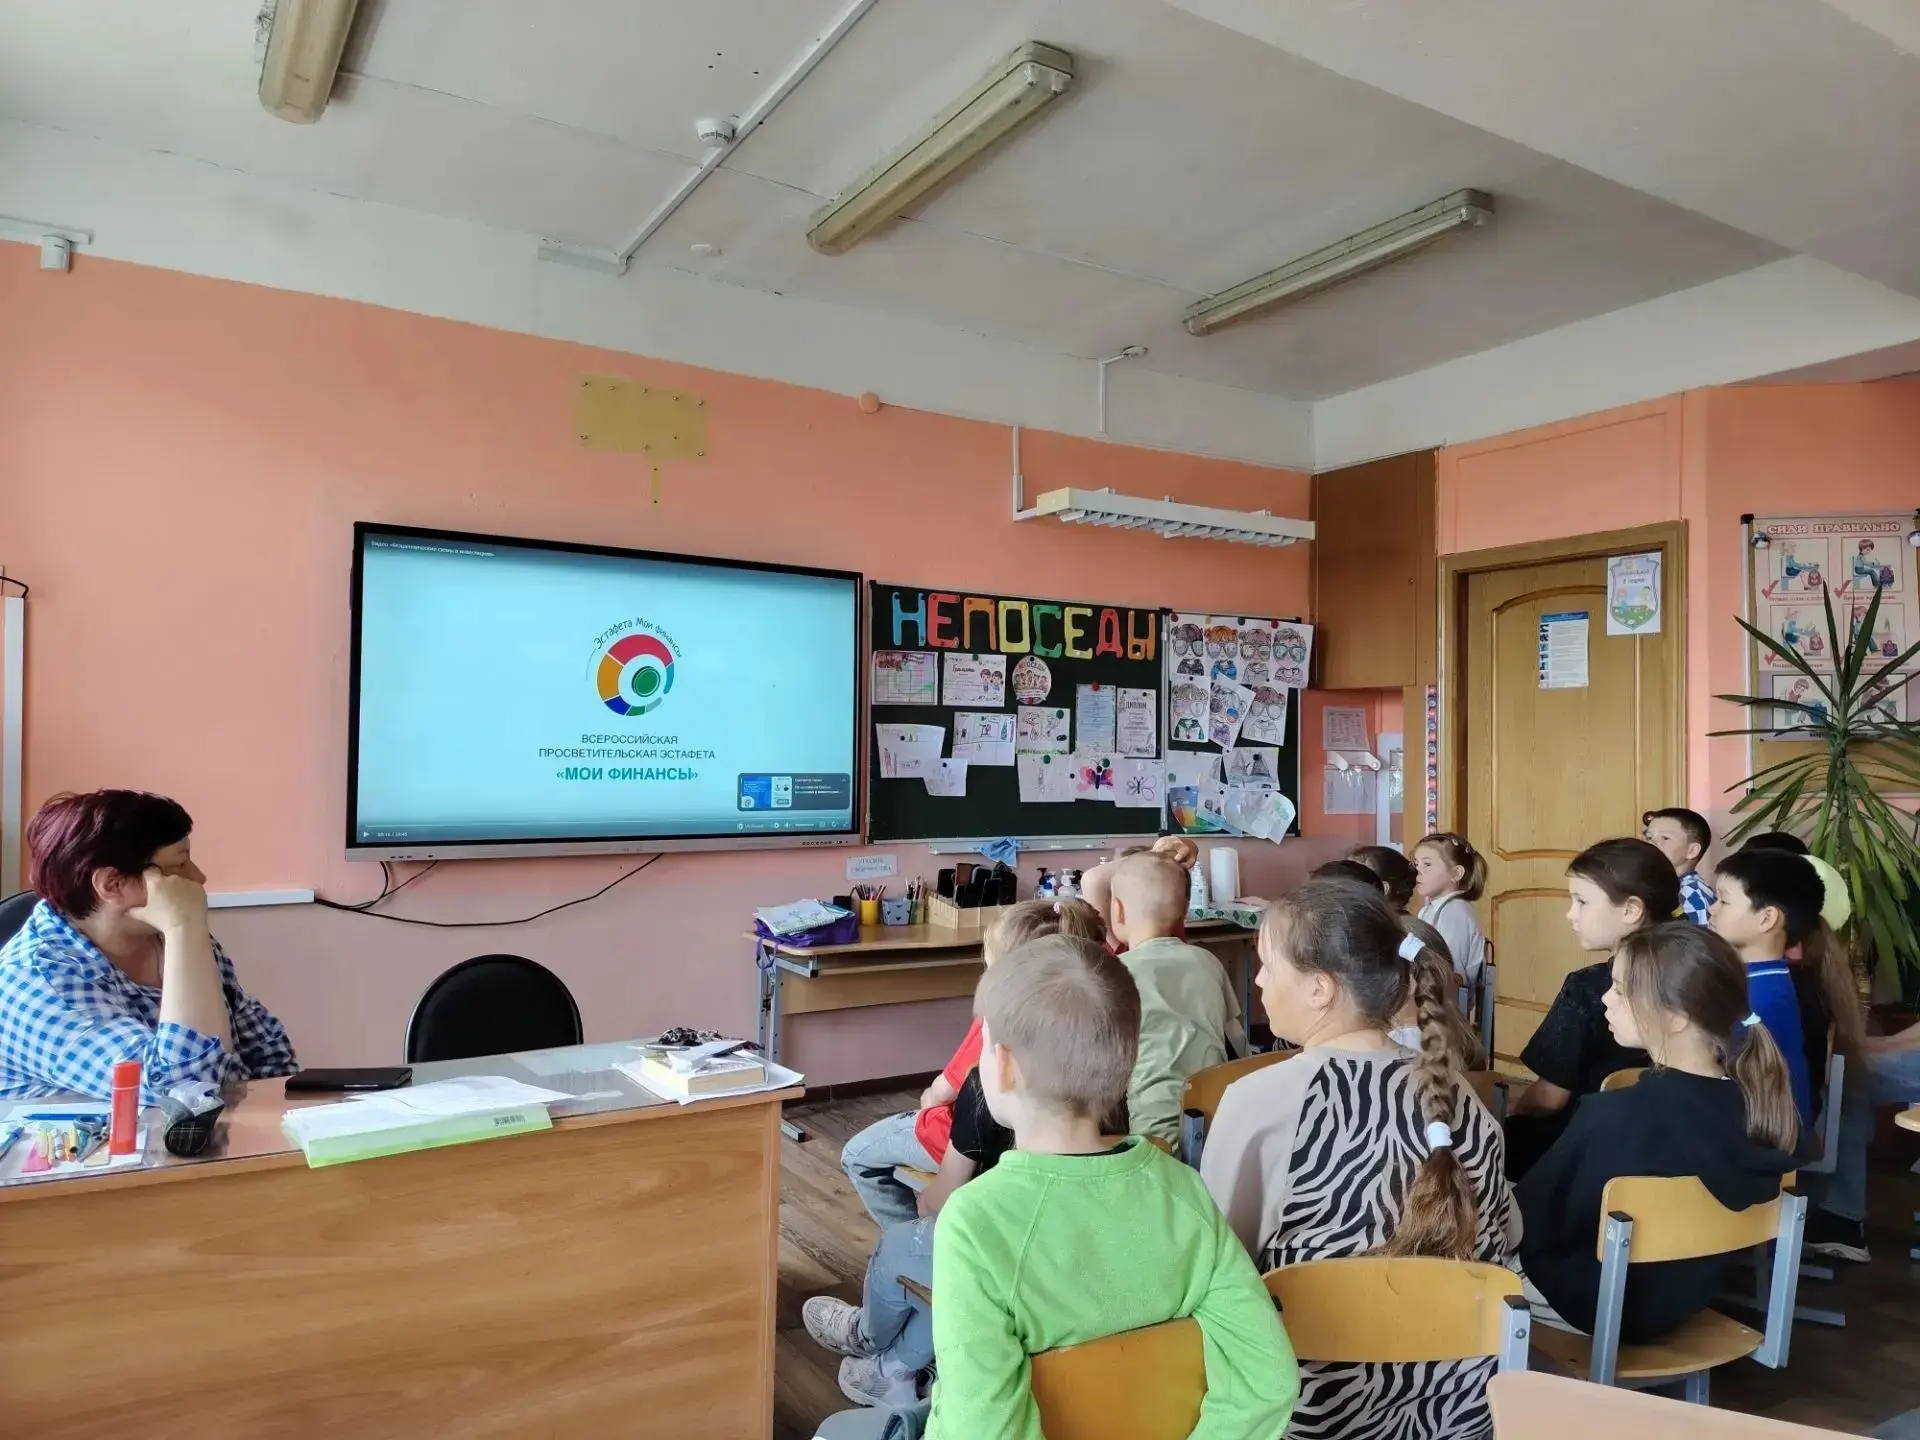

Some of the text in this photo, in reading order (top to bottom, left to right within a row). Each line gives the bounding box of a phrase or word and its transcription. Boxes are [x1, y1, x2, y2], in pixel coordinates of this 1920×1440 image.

[1767, 522, 1901, 535] СИДИ ПРАВИЛЬНО
[371, 540, 389, 548] Видео
[892, 592, 1156, 661] НЕПОСЕДЫ
[593, 617, 682, 658] Эстафета Мои финансы
[581, 734, 678, 745] ВСЕРОССИЙСКАЯ
[539, 748, 716, 760] ПРОСВЕТИТЕЛЬСКАЯ ЭСТАФЕТА
[556, 767, 698, 781] «МОИ ФИНАНСЫ»
